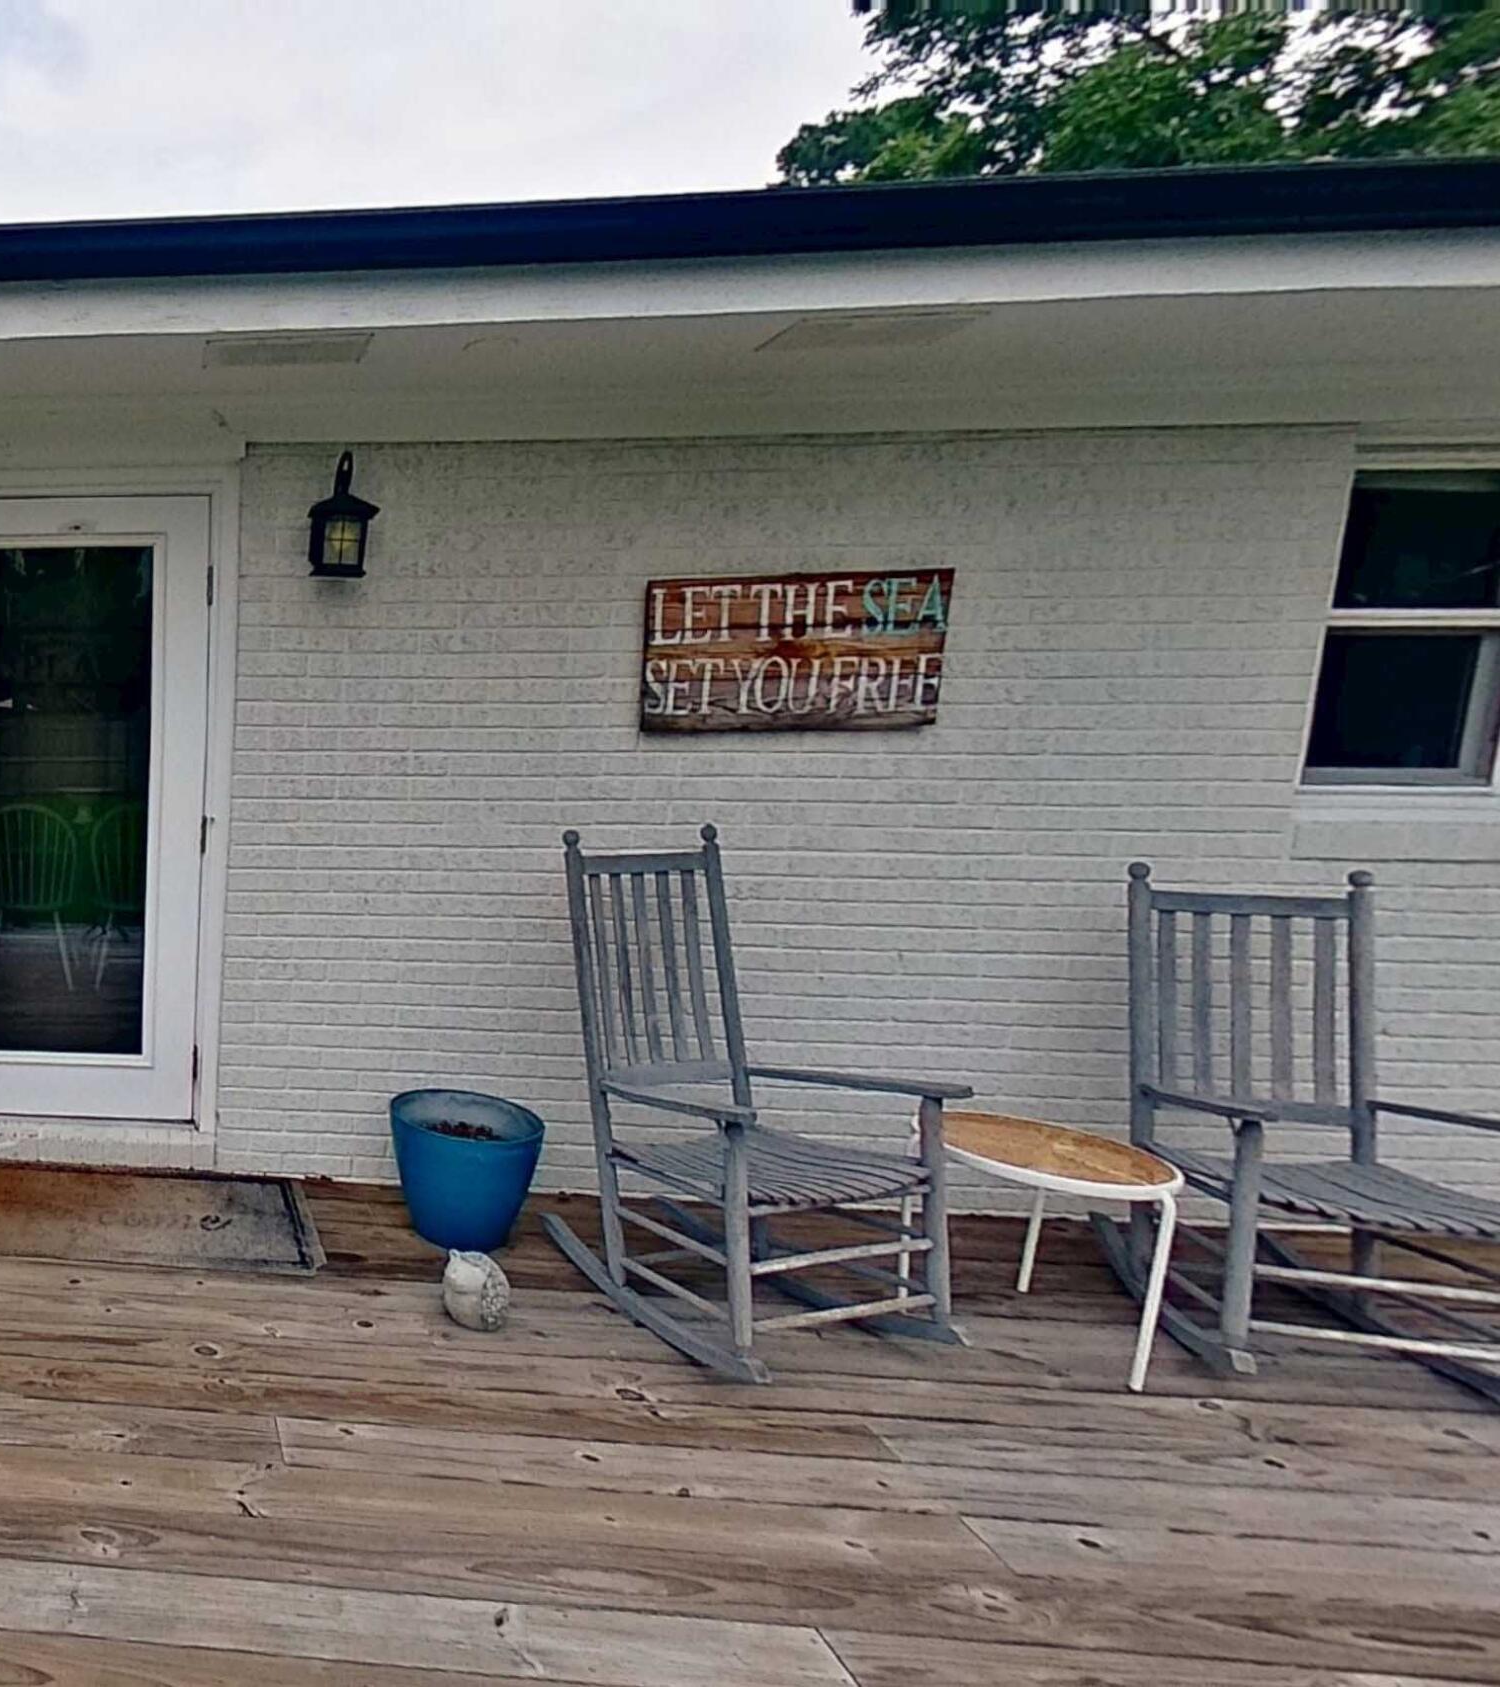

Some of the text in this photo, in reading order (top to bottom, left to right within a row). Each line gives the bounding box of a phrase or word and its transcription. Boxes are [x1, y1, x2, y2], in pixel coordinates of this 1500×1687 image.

[649, 574, 947, 645] LET THE SEA
[645, 653, 943, 716] SET YOU FREE
